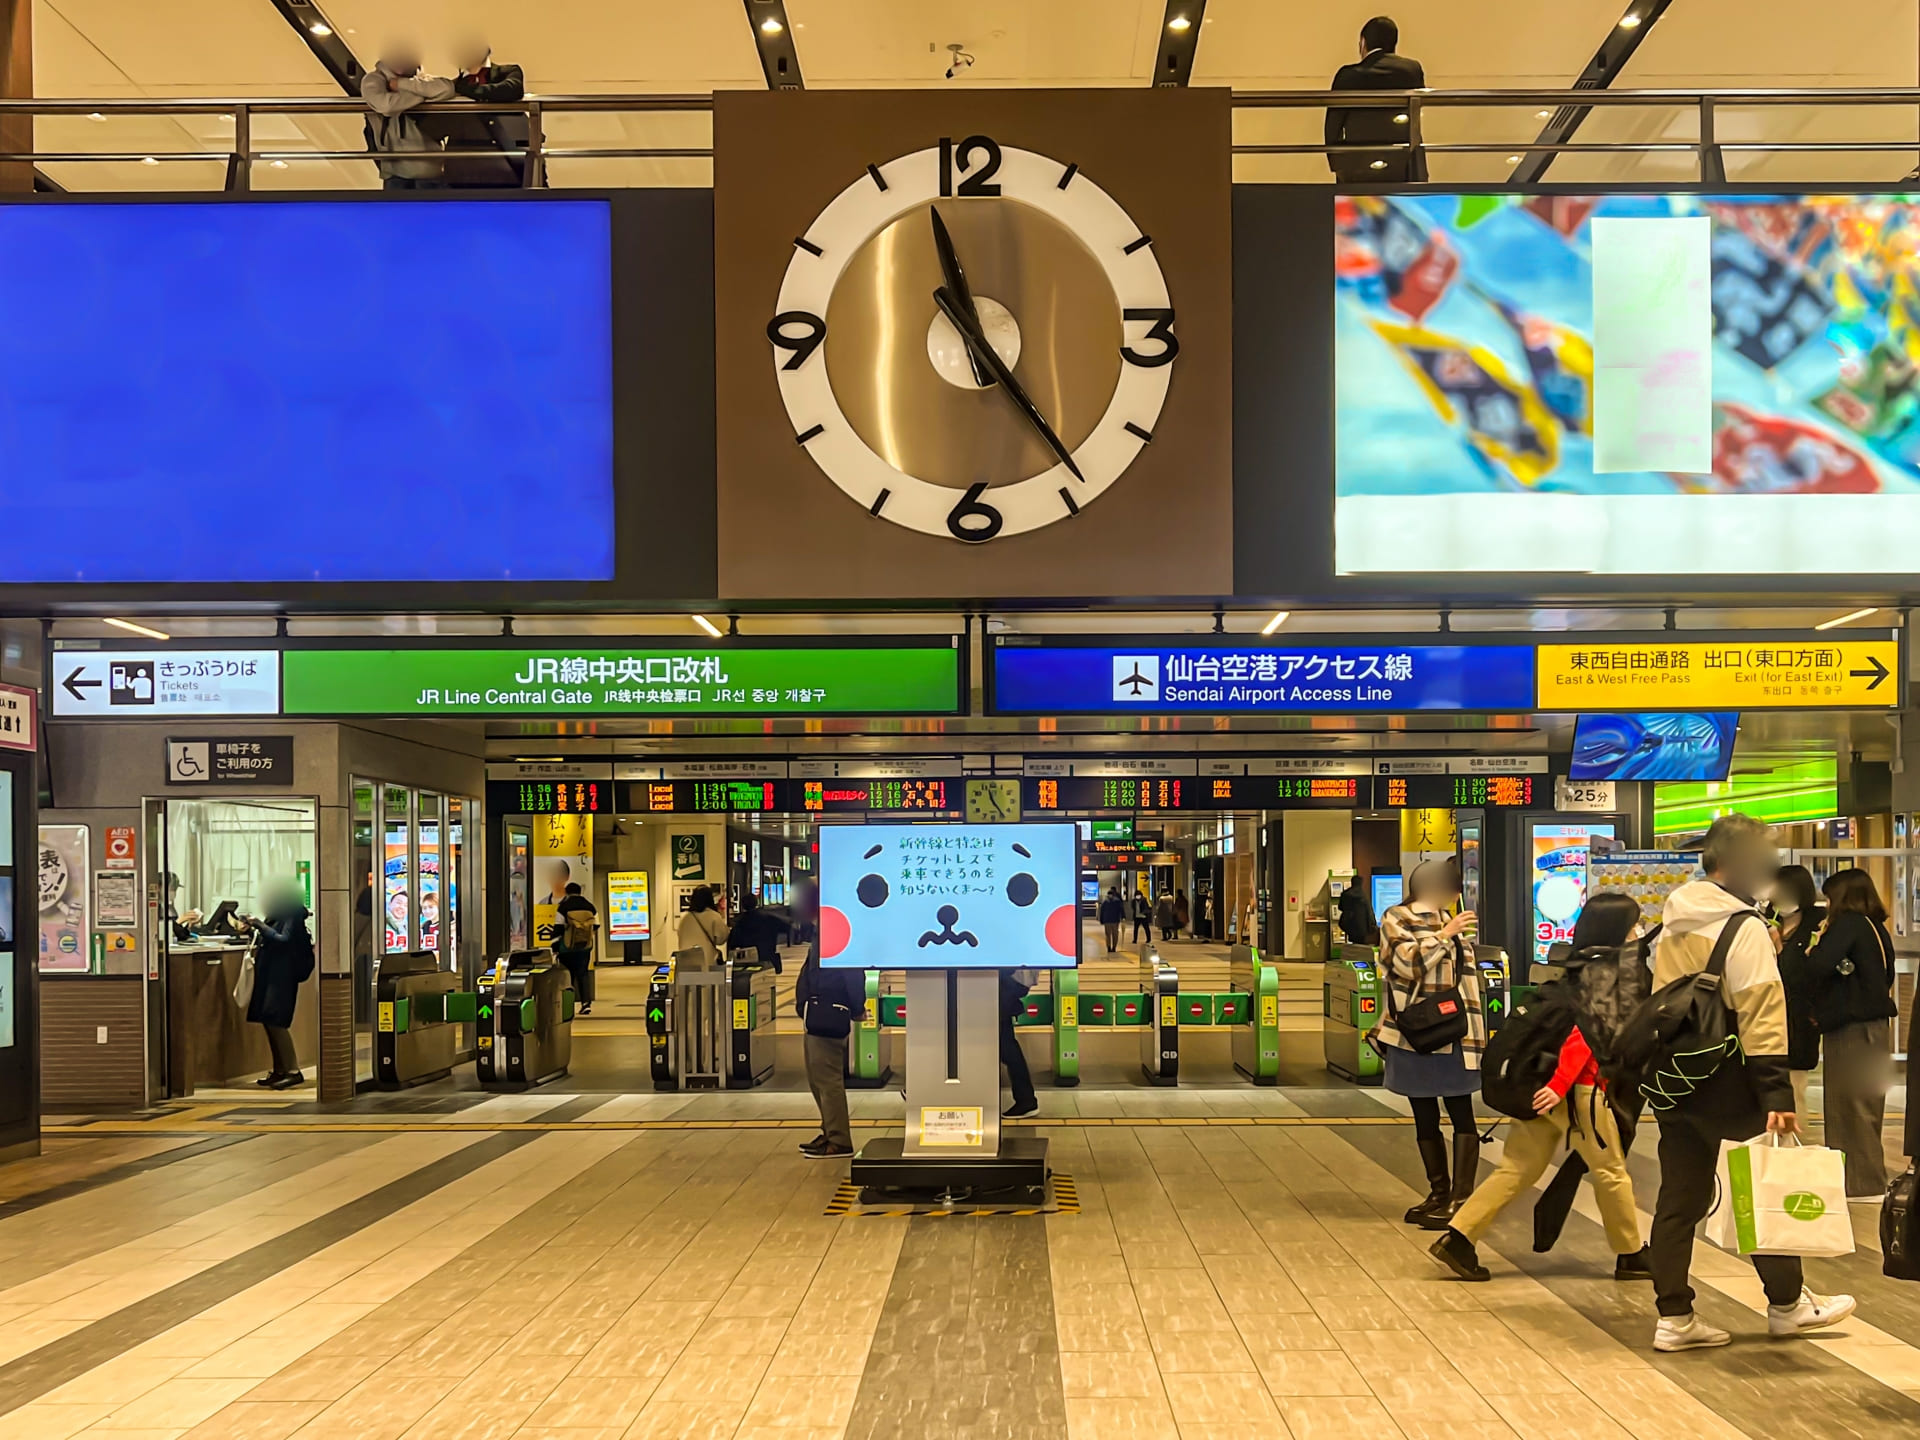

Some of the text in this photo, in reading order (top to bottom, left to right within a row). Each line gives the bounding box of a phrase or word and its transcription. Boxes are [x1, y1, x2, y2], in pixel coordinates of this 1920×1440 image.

[939, 135, 1002, 198] 12
[767, 311, 827, 371] 9
[1119, 309, 1180, 368] 3
[947, 482, 1003, 542] 6
[1570, 650, 1691, 670] 東西自由通路
[159, 659, 258, 677] きっぷうりば
[514, 656, 729, 685] JR線中央口改札
[1165, 654, 1413, 682] 仙台空港アクセス線
[1556, 672, 1691, 685] East & West Free Pass
[1735, 670, 1844, 683] Exit (for East Exit)
[159, 680, 199, 691] Tickets
[416, 688, 593, 705] JR Line Central Gate
[603, 688, 702, 704] JR线中央检票口
[712, 688, 827, 703] JR선 중앙 개찰구
[1165, 685, 1393, 705] Sendai Airport Access Line
[215, 743, 261, 755] 車椅子を
[216, 757, 274, 770] ご利用の方
[649, 783, 673, 792] Local
[649, 792, 673, 801] Local
[649, 801, 673, 810] Local
[111, 828, 129, 836] AED
[900, 836, 994, 850] 新幹線と特急は
[901, 853, 995, 866] チケットレスで
[900, 867, 994, 881] 乗車できるのを
[1358, 971, 1375, 982] IC
[1361, 999, 1375, 1013] IC
